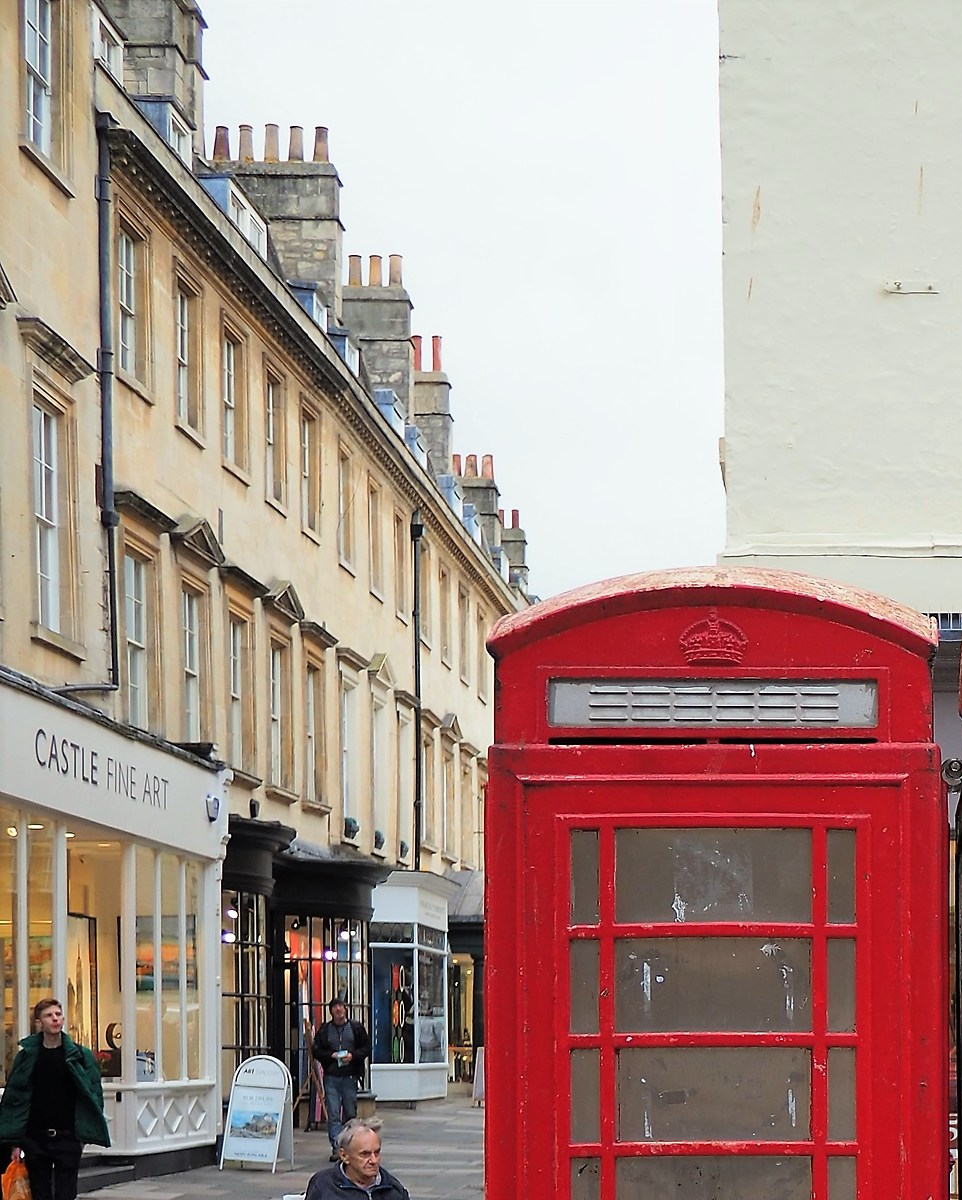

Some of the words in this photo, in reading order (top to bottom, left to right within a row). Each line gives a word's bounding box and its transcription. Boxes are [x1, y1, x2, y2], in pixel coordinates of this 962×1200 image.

[35, 728, 99, 786] CASTLE
[106, 757, 137, 800] FINE
[142, 773, 169, 810] ART
